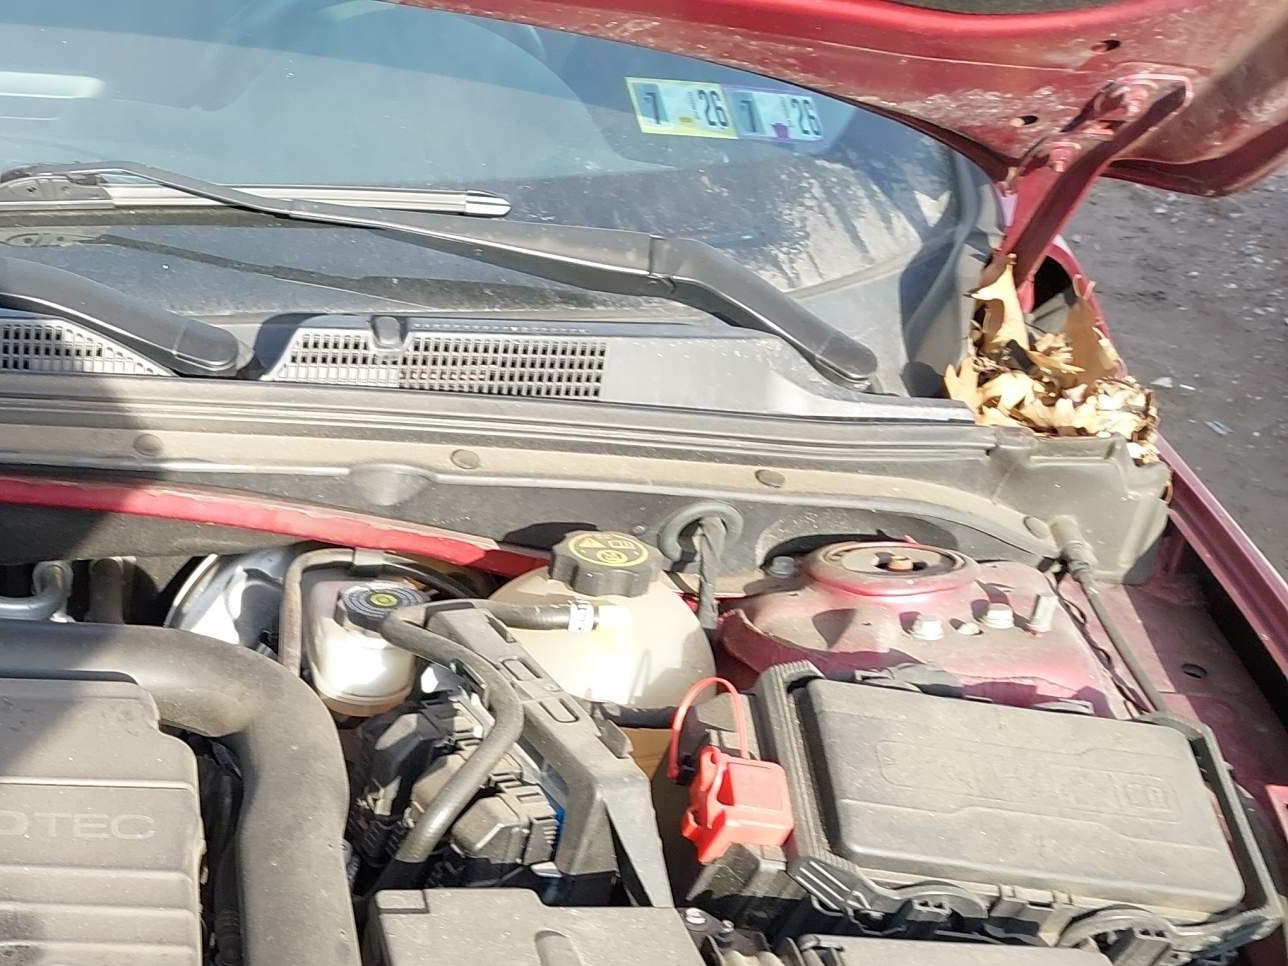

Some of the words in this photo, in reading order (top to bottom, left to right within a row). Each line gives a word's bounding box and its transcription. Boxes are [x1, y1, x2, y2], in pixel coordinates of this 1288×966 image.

[643, 91, 661, 125] 7
[697, 89, 730, 128] 26
[791, 97, 822, 136] 26
